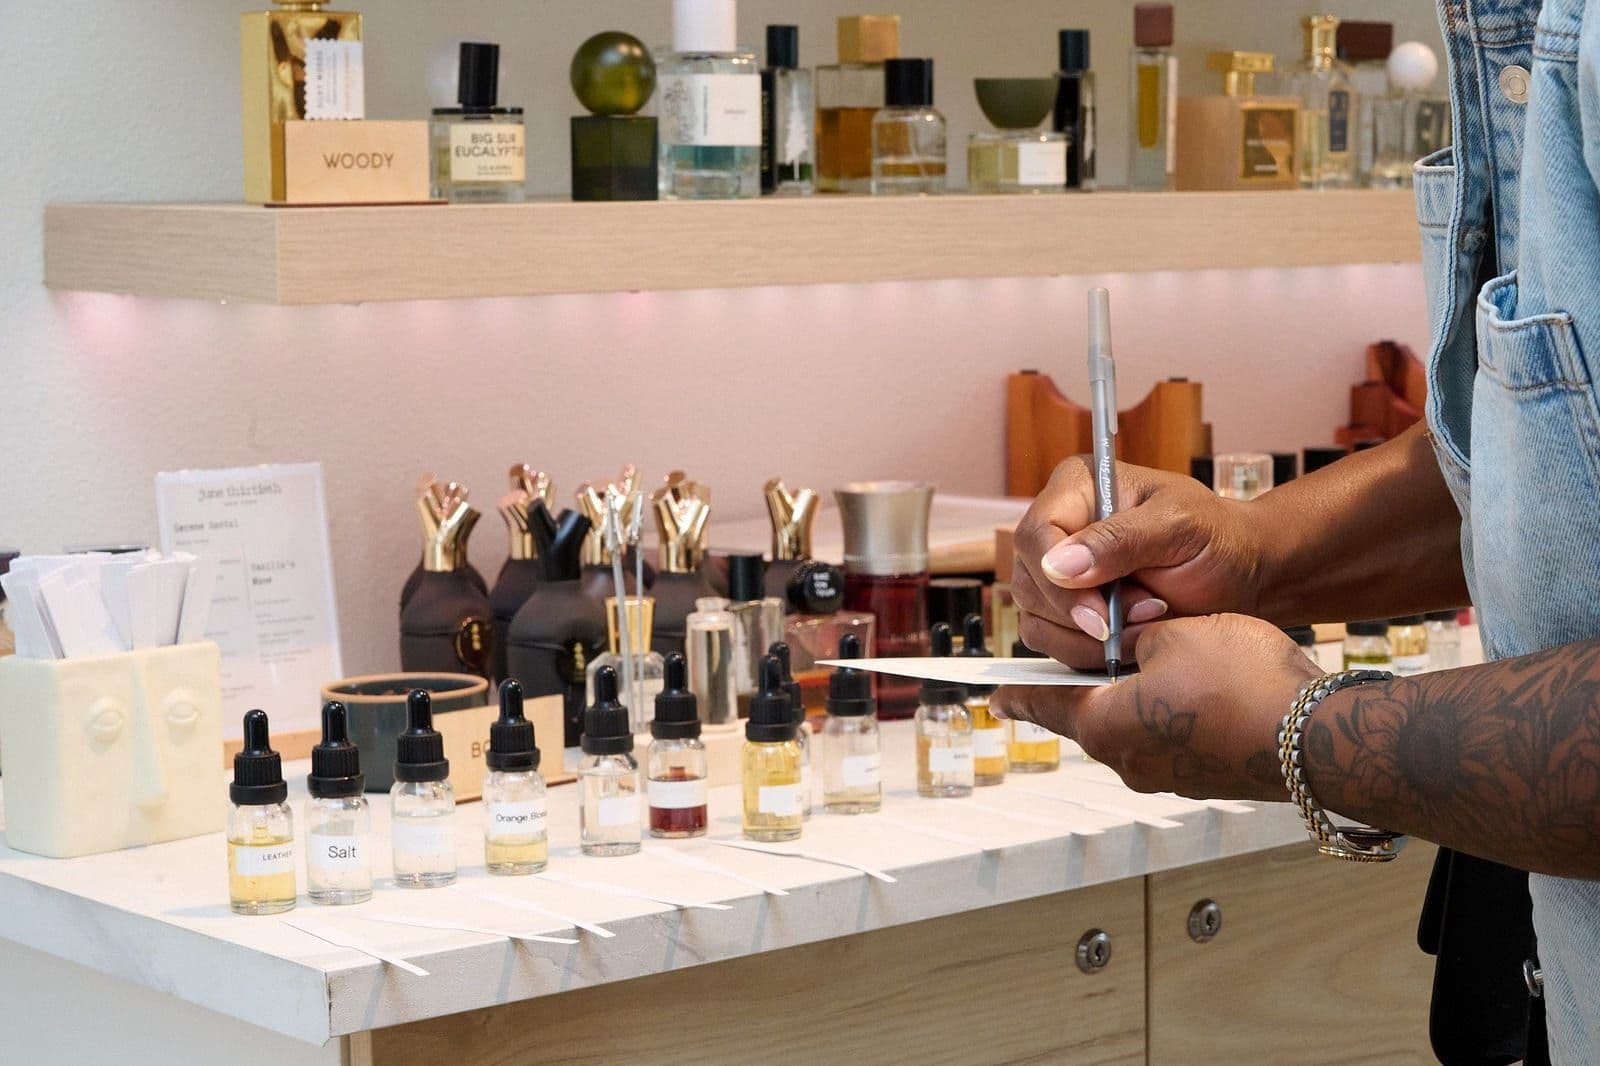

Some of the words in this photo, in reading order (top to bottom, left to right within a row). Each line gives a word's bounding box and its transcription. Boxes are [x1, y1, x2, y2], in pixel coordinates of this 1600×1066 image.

[471, 133, 493, 144] BIG
[322, 152, 395, 169] WOODY
[496, 813, 528, 823] Orange
[328, 845, 356, 859] Salt
